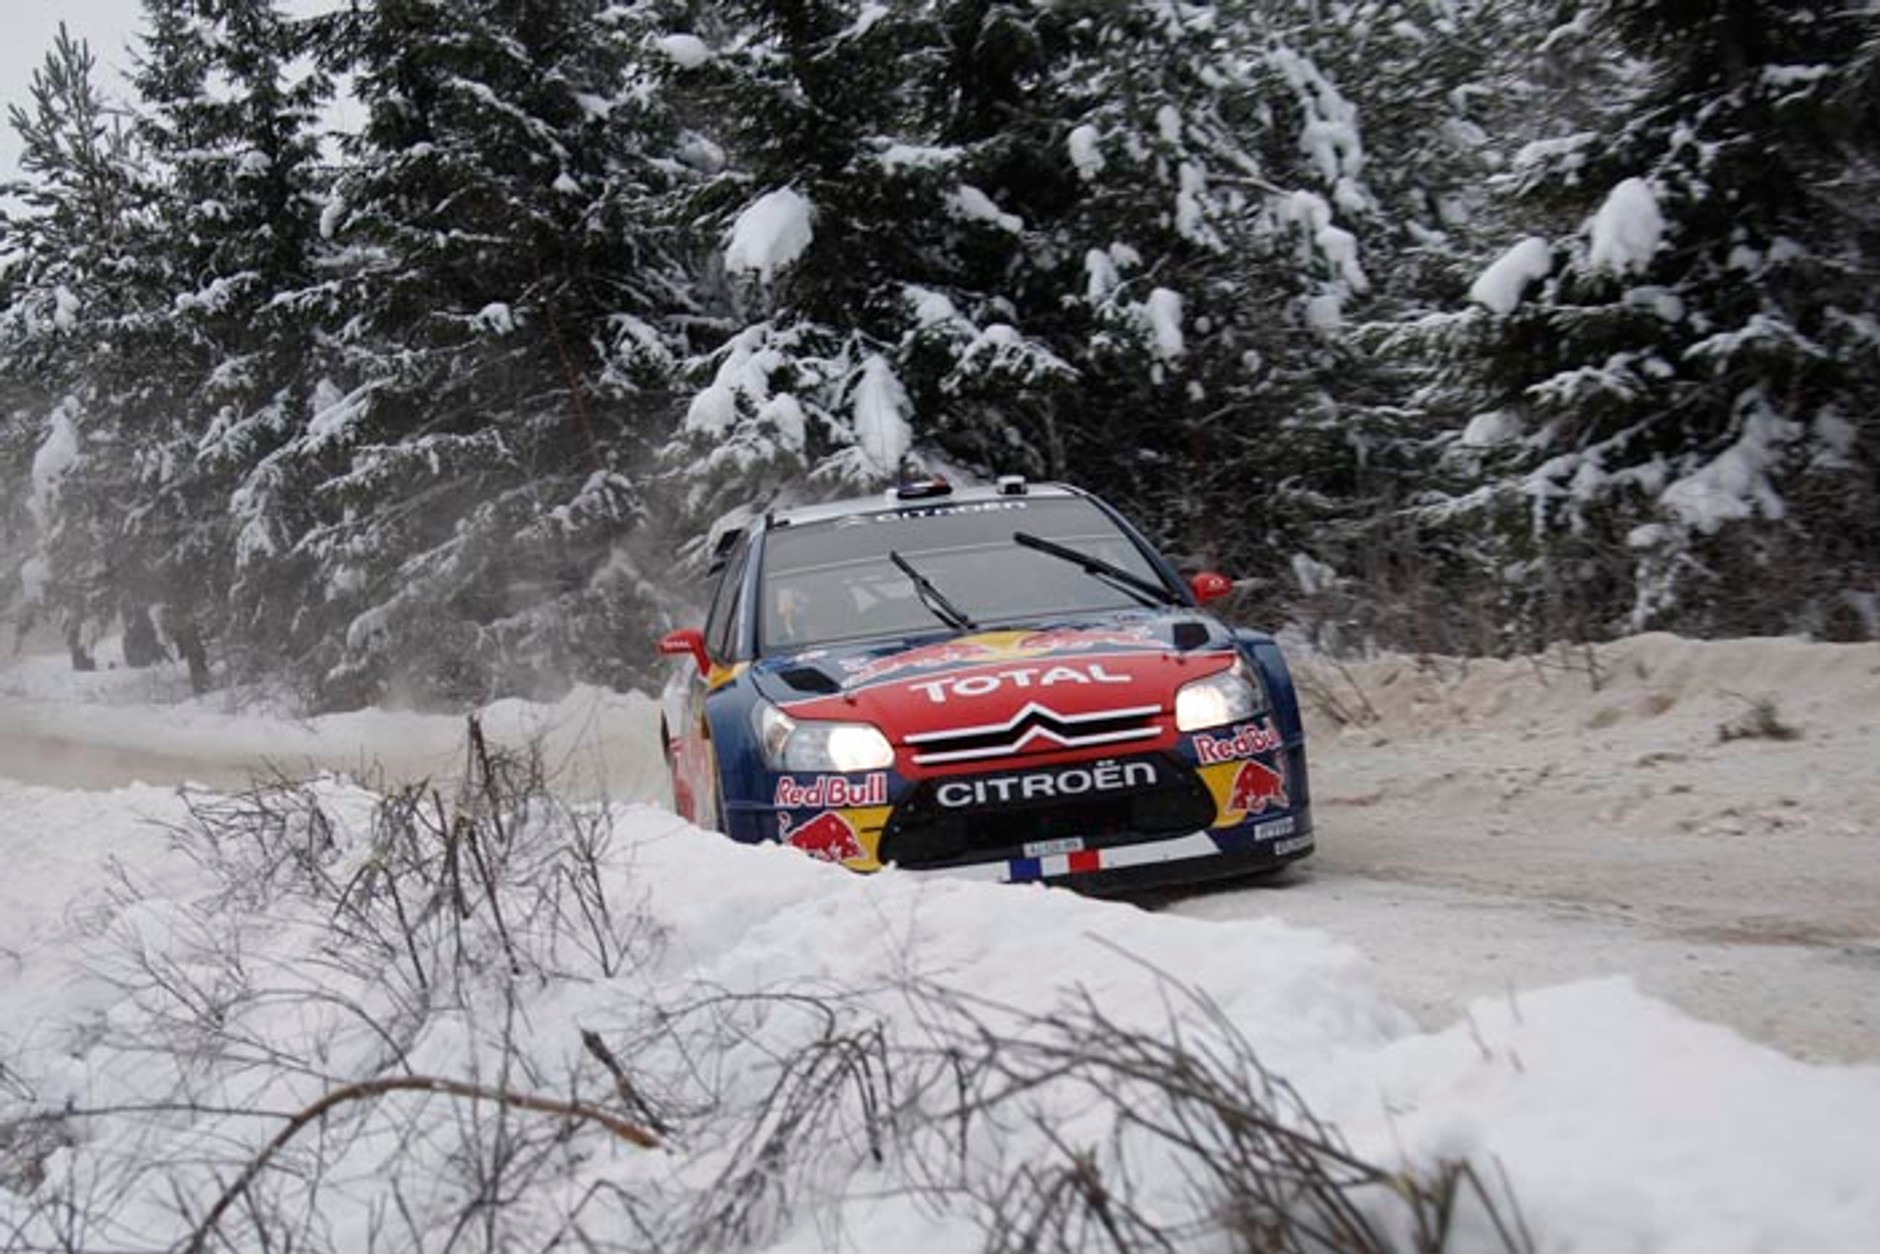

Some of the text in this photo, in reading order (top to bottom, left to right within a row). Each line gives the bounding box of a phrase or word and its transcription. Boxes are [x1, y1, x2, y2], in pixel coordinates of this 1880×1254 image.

[908, 664, 1132, 702] TOTAL
[1193, 725, 1250, 764] Red
[774, 772, 887, 808] Red Bull
